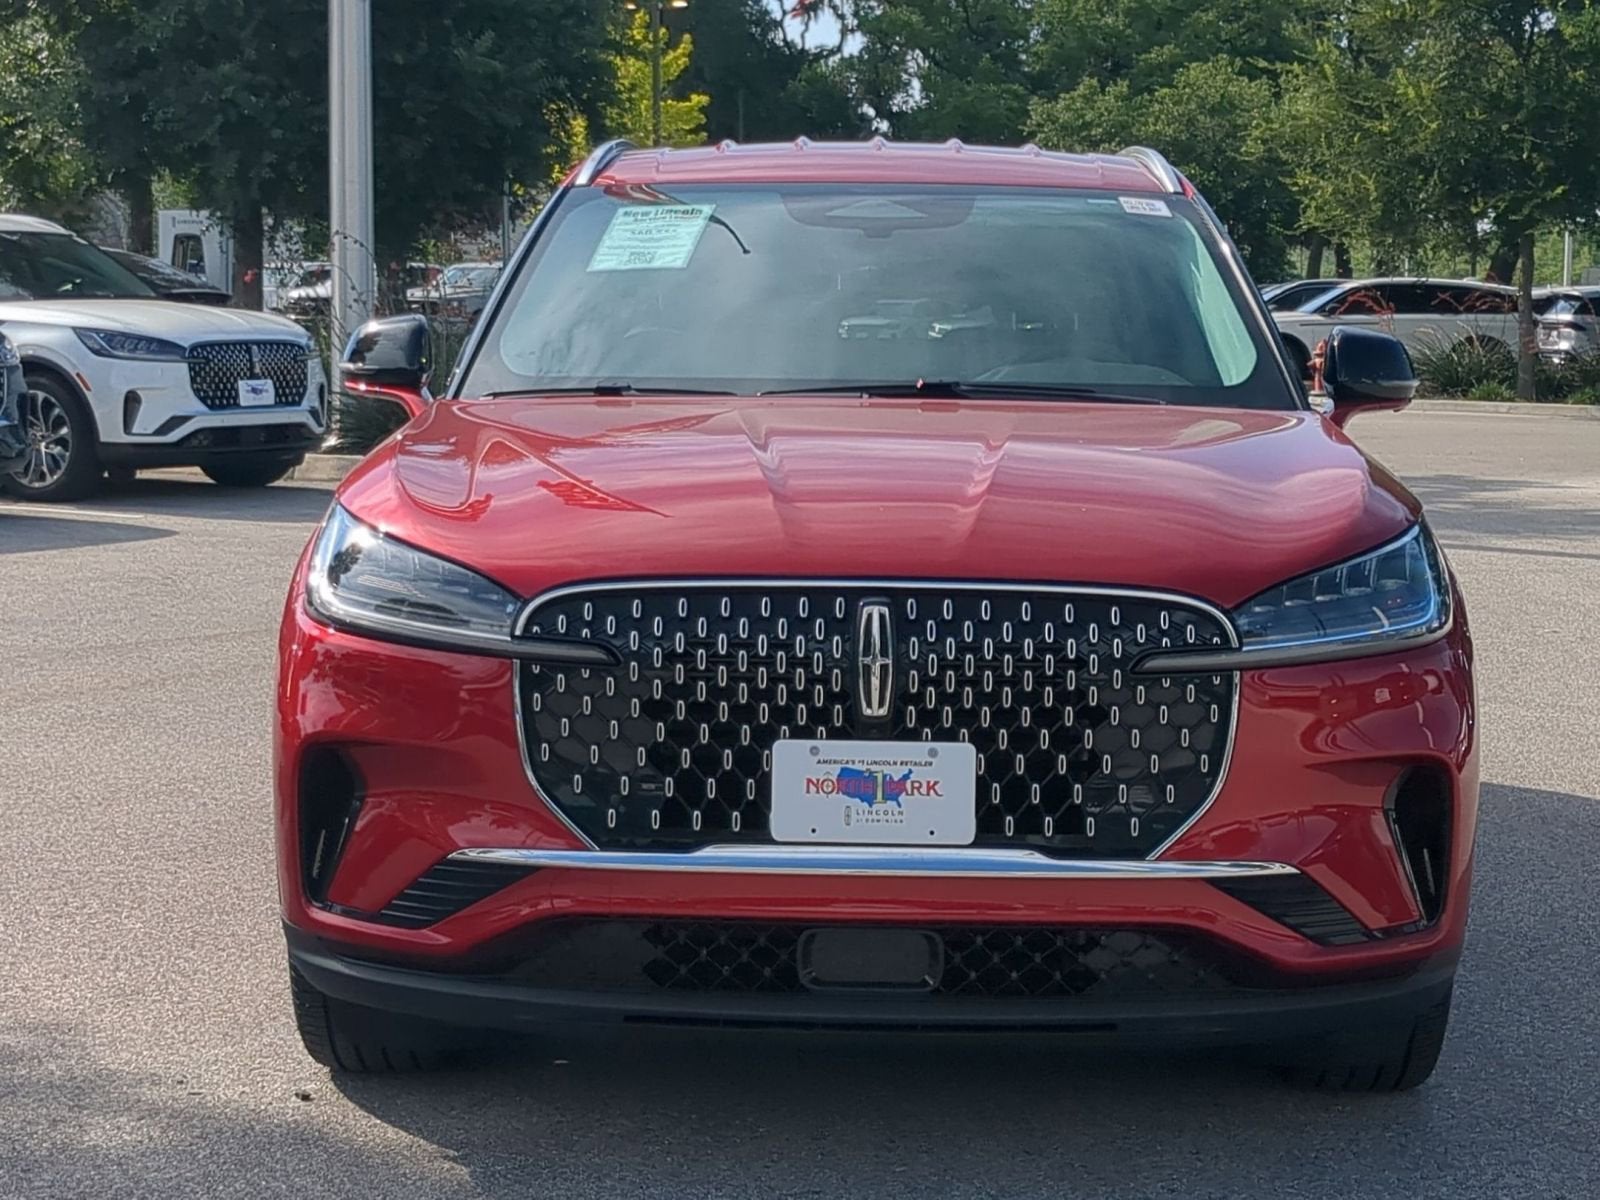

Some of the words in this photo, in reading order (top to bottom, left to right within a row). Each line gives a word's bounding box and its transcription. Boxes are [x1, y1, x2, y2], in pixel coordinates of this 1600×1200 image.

[816, 758, 856, 766] AMERICA'S
[866, 759, 898, 767] LINCOLN
[899, 760, 934, 768] RETAILER
[805, 777, 874, 796] NORTH
[886, 779, 944, 798] PARK
[856, 808, 905, 817] LINCOLN
